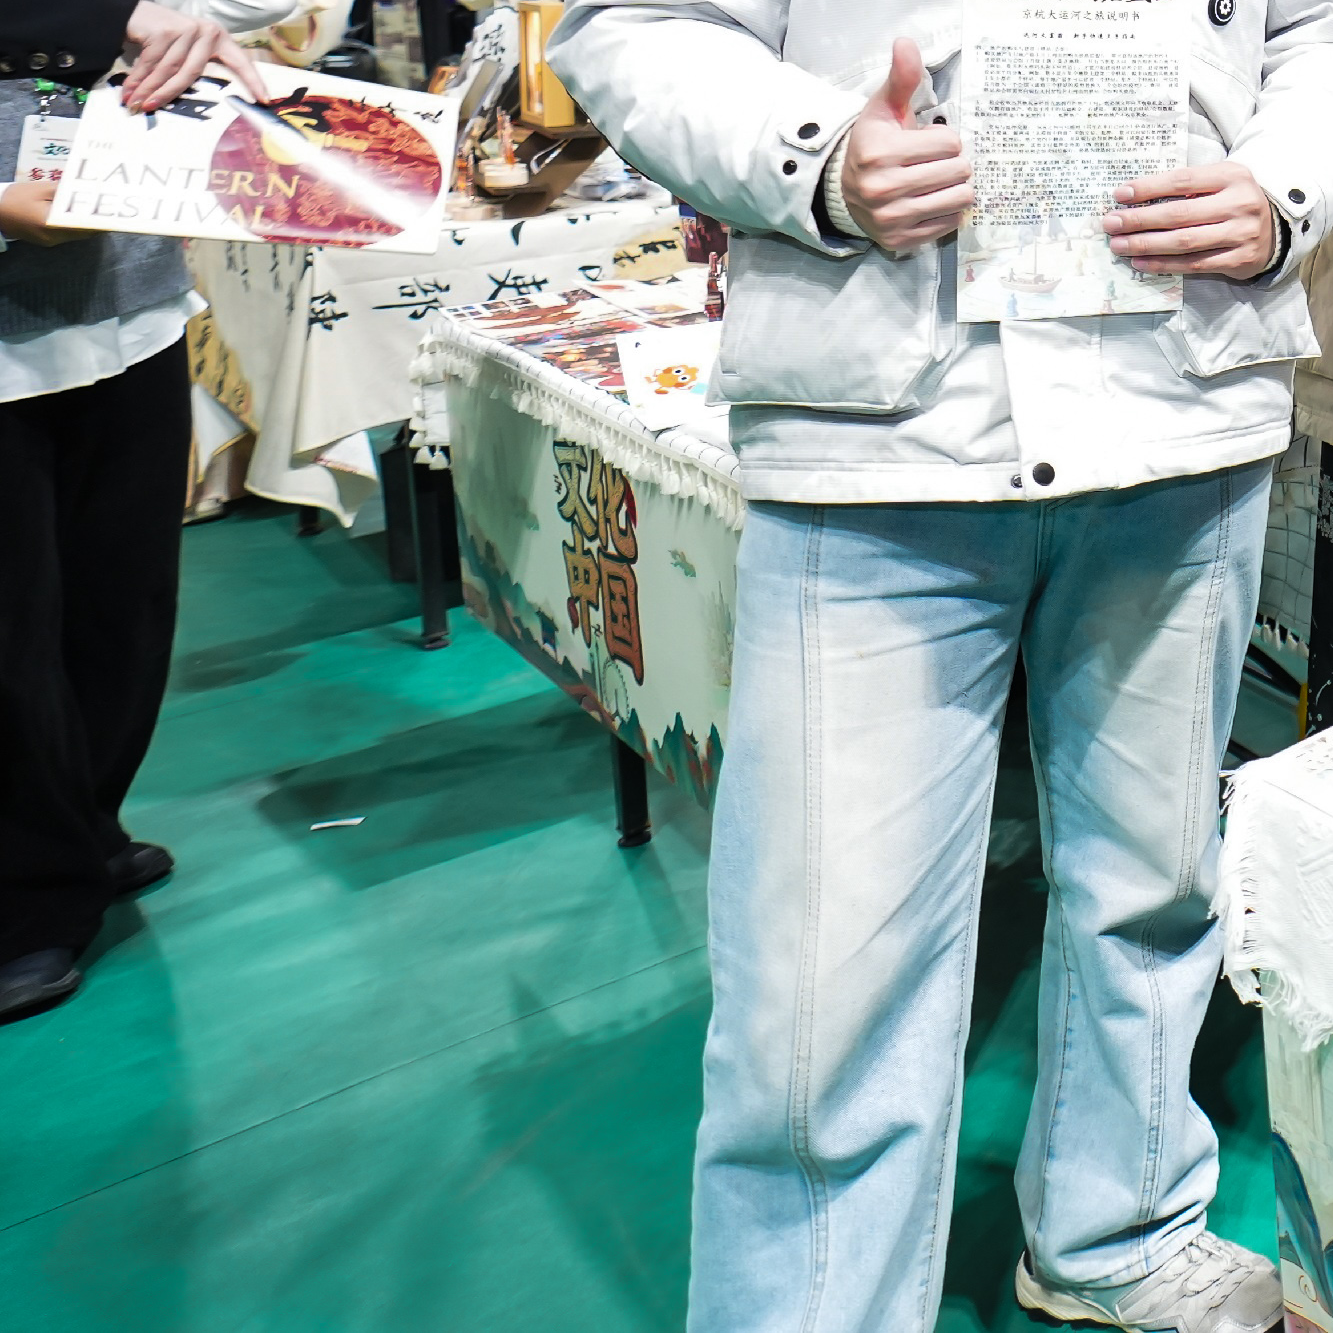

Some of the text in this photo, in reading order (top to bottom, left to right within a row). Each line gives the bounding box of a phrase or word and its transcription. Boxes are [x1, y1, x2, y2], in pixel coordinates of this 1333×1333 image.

[1022, 9, 1140, 22] 京杭大运河之旅说明书
[75, 161, 299, 199] LANTERN
[64, 190, 267, 228] FESTIVAL
[562, 520, 644, 686] 中国
